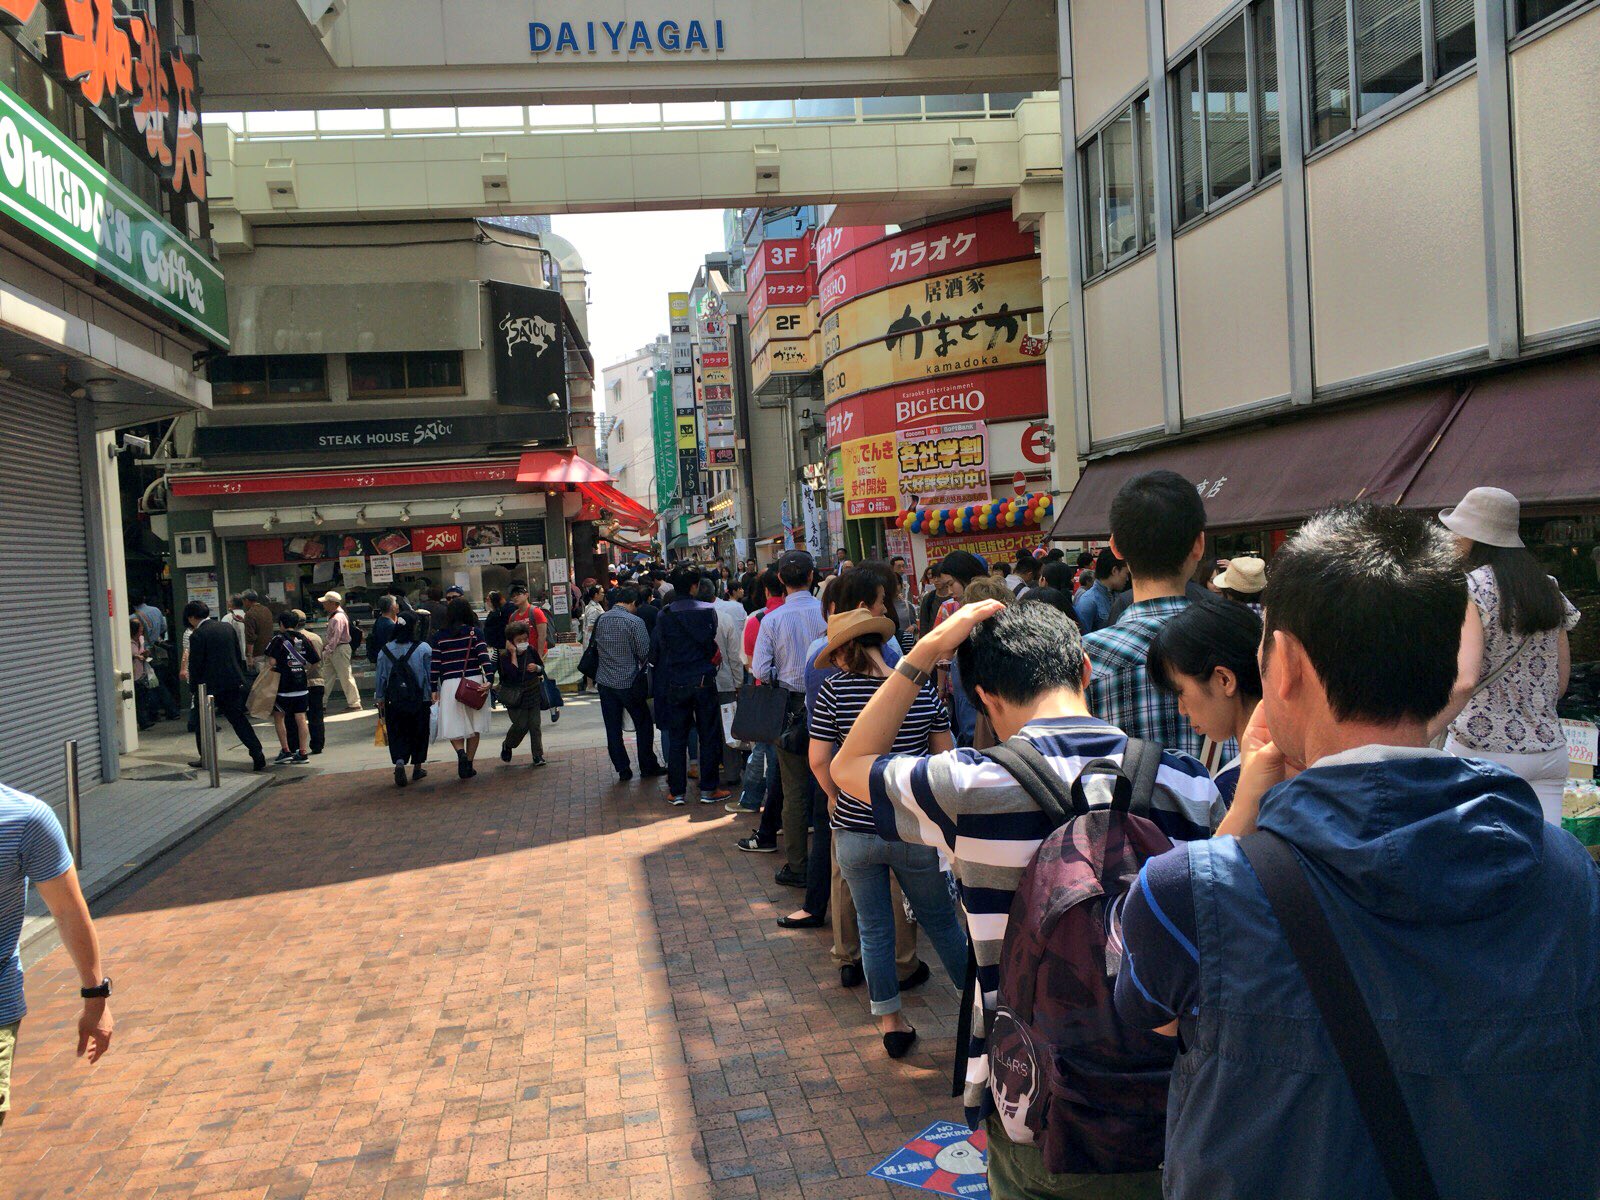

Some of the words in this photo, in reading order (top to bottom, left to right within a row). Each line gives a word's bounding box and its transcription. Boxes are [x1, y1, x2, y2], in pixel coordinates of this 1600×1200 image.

[529, 20, 724, 52] DAIYAGAI
[771, 247, 798, 265] 3F
[889, 232, 977, 272] カラオケ
[141, 230, 205, 314] Coffee
[767, 284, 805, 295] カラオケ
[925, 271, 986, 303] 居酒家
[776, 315, 801, 331] 2F
[926, 355, 999, 374] kamadoka
[902, 389, 925, 399] Karaoke
[926, 382, 974, 395] Entertainment
[896, 399, 927, 423] BIG
[930, 390, 985, 411] ECHO
[319, 435, 361, 446] STEAK
[367, 432, 409, 444] HOUSE
[413, 419, 453, 445] SATOU
[943, 424, 974, 433] SoftBank
[663, 430, 675, 478] PALAZZO
[898, 435, 984, 473] 各社学割
[851, 477, 887, 497] 受付開始
[899, 469, 987, 495] 大好評受付中!
[425, 530, 458, 550] SATOU
[924, 1129, 974, 1141] SMOKING
[937, 1125, 954, 1133] NO
